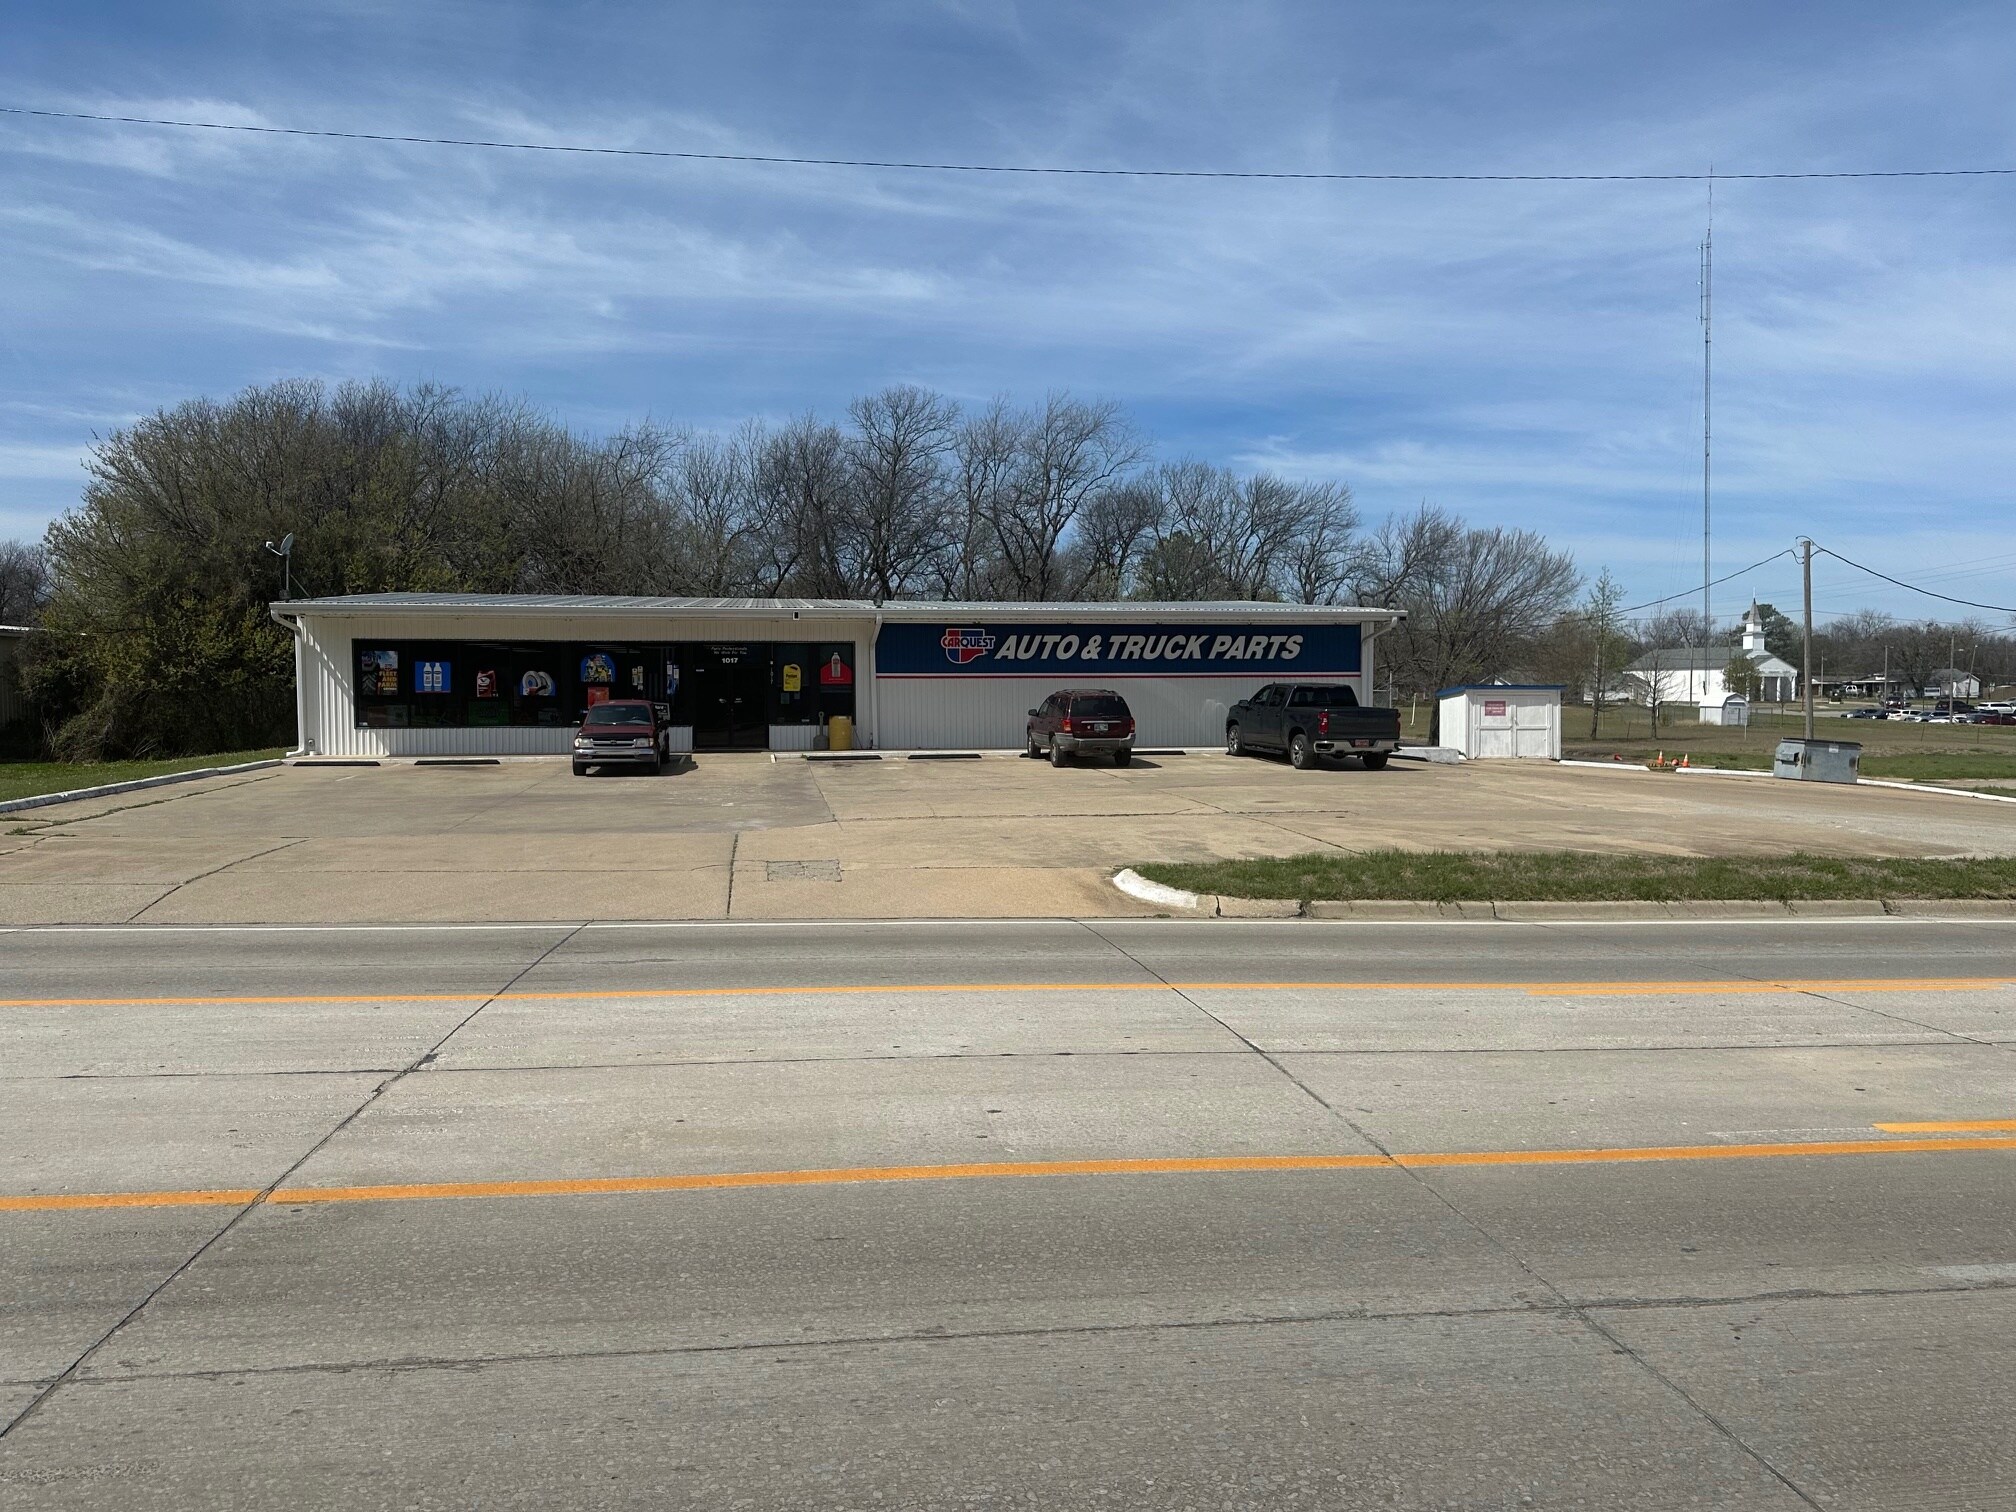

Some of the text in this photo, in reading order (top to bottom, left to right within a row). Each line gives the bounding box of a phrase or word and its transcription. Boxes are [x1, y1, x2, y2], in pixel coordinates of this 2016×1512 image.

[942, 637, 995, 648] CARQUEST
[994, 634, 1304, 660] AUTO & TRUCK PARTS
